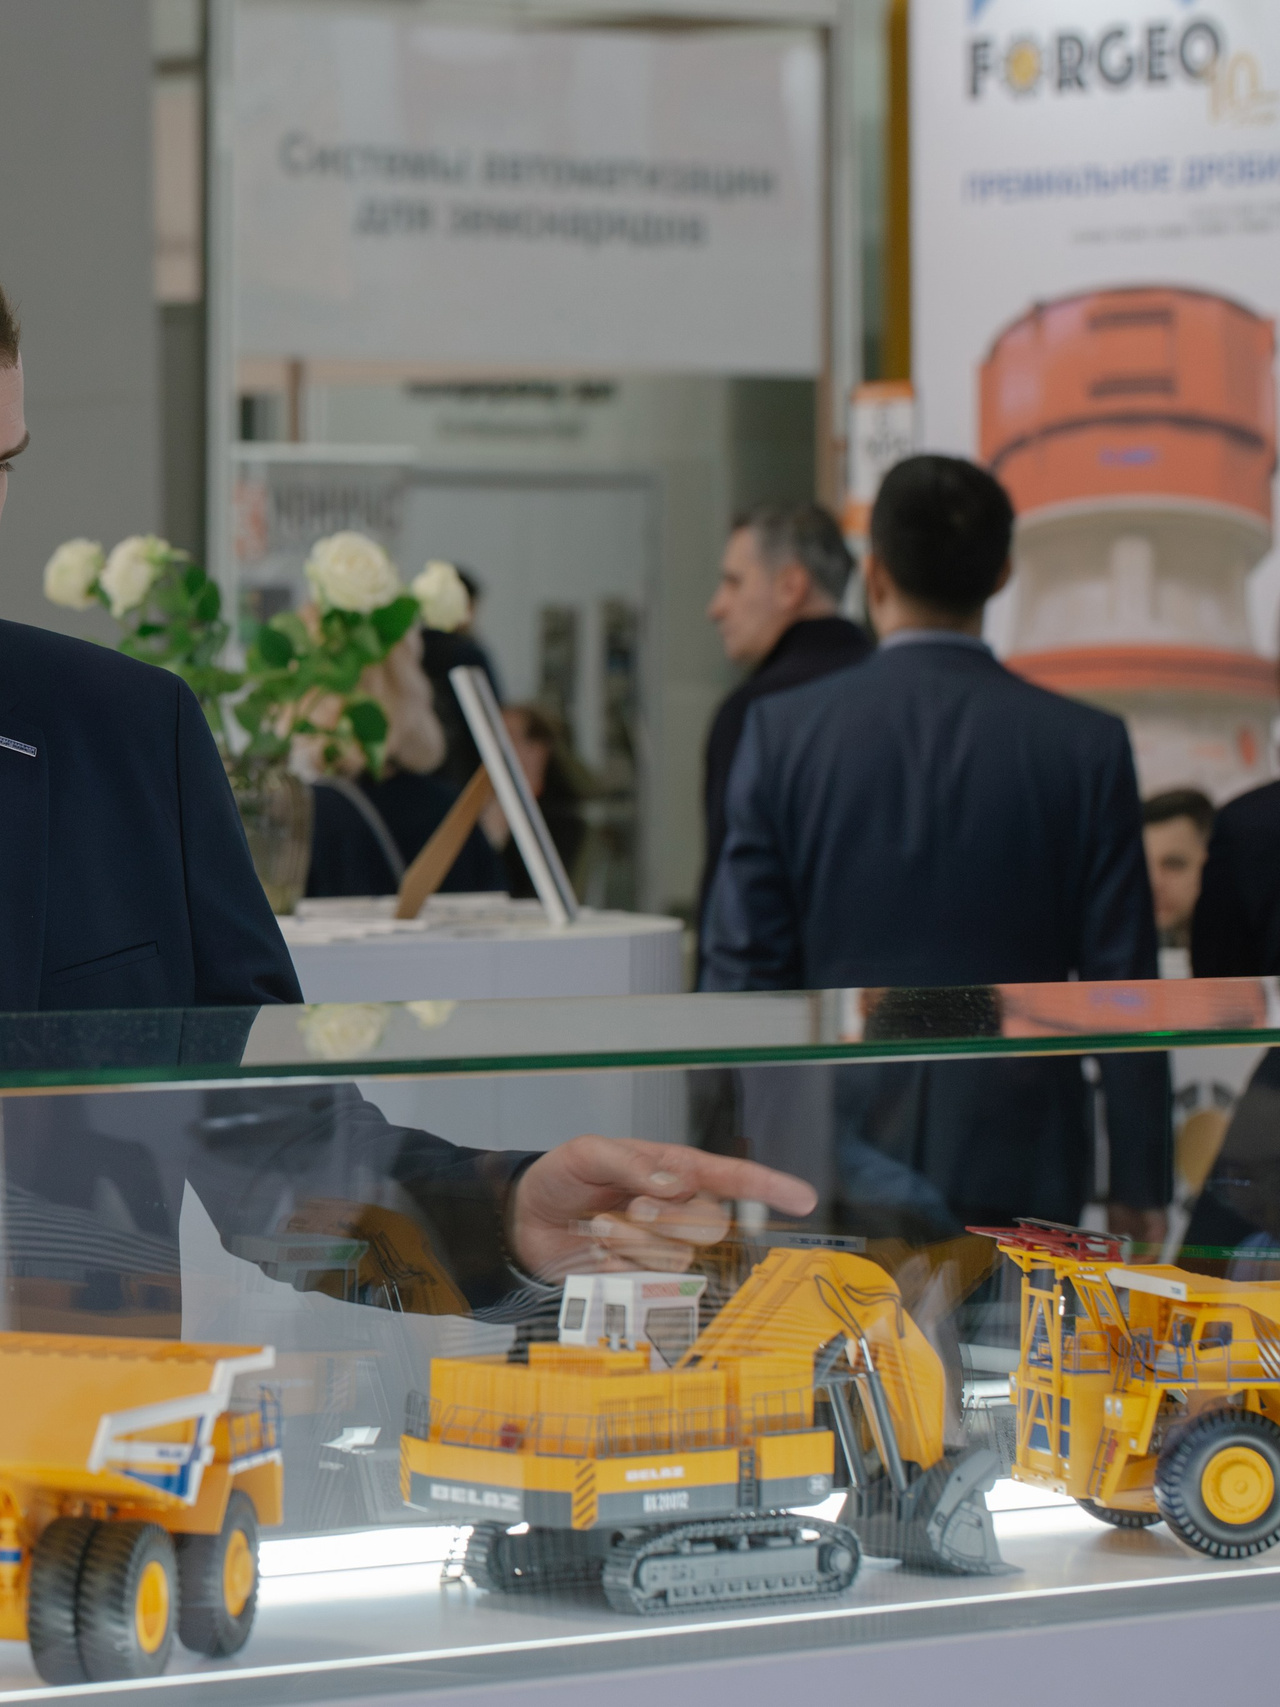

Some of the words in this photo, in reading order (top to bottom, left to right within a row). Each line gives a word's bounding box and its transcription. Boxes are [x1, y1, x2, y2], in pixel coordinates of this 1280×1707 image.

[279, 130, 469, 185] Системы
[625, 1466, 685, 1482] BELAZ
[430, 1483, 521, 1511] BELAZ
